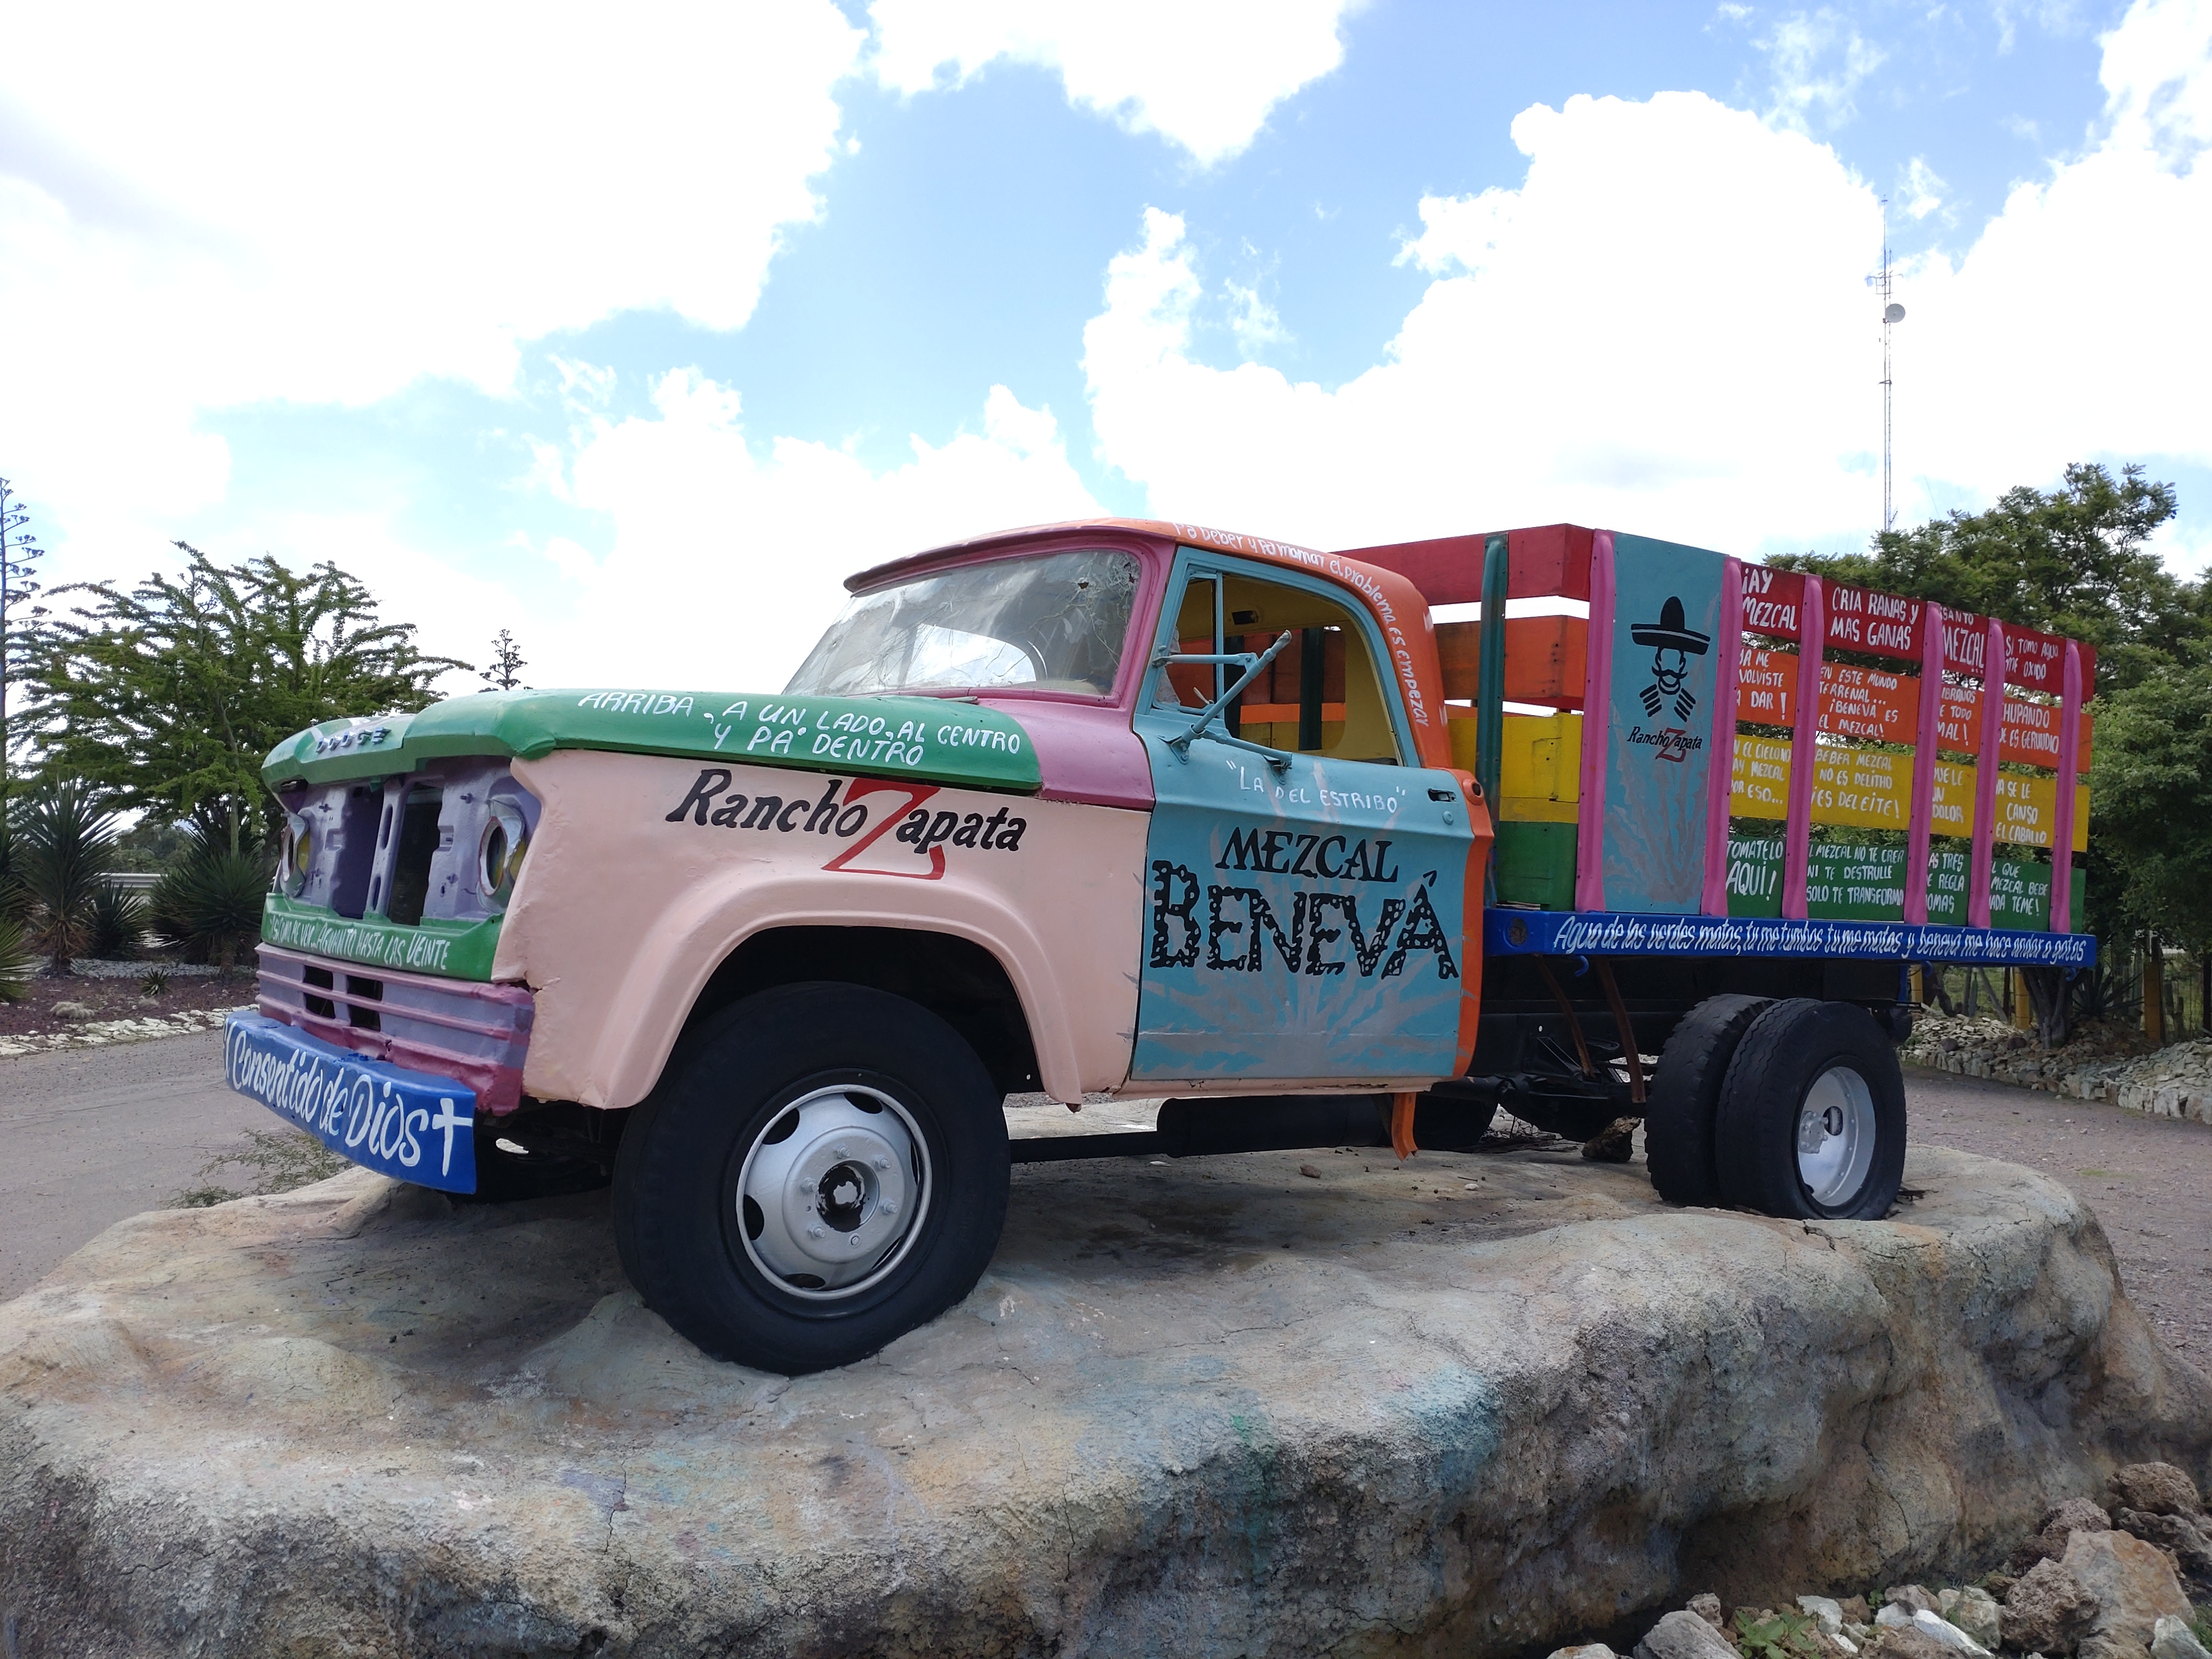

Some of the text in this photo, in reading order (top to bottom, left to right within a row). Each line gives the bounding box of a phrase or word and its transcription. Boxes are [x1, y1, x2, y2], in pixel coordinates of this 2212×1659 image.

[1199, 526, 1243, 549] beber
[1248, 536, 1258, 553] y
[1277, 543, 1325, 568] mamar
[1329, 559, 1344, 577] el
[1344, 566, 1396, 624] problema
[1743, 596, 1797, 631] MEZCAL
[1832, 587, 1862, 612] CRIA
[1868, 593, 1906, 622] RANAS
[1830, 616, 1911, 650] MAS GANAS
[2006, 635, 2014, 656] SI
[1756, 651, 1770, 667] ME
[1839, 669, 1864, 685] ESTE
[1867, 673, 1897, 690] MUNDO
[2023, 661, 2046, 680] OXIDO
[1942, 687, 1976, 703] IBRANOS
[1885, 709, 1898, 723] ES
[1939, 705, 1971, 720] E TODO
[2003, 703, 2050, 728] HUPANDO
[722, 701, 749, 720] A
[759, 704, 807, 726] UN
[897, 721, 926, 744] AL
[937, 725, 1020, 754] CENTRO
[1818, 714, 1884, 738] EL MEZCAL!
[316, 727, 392, 753] DODGE
[713, 726, 734, 750] Y
[812, 732, 924, 766] DENTRO
[1627, 726, 1702, 763] Rancho Zapata
[1734, 739, 1740, 755] N
[1743, 742, 1752, 758] EL
[2021, 731, 2059, 754] GERUNDIO
[1733, 758, 1785, 781] AY MEZCAL
[1856, 754, 1892, 771] MEZCAL
[1819, 768, 1834, 781] NO
[1837, 770, 1848, 786] ES
[1275, 786, 1311, 804] DEL
[2007, 781, 2017, 797] SE
[2021, 783, 2031, 799] LE
[665, 768, 1028, 880] Rancho Zapata
[1933, 804, 1964, 824] DOLOR
[2006, 802, 2038, 825] CANSO
[1996, 822, 2047, 844] EL CABALLO
[1215, 827, 1399, 882] MEZCAL
[1726, 840, 1783, 860] TOMATELO
[1815, 845, 1852, 859] MEZCAL
[1854, 846, 1866, 862] NO
[1869, 847, 1879, 863] TE
[1881, 849, 1904, 863] CREA
[1807, 865, 1892, 880] NI TE DESTRULLE
[1928, 853, 1964, 872] AS TRES
[2002, 863, 2021, 878] QUE
[1938, 874, 1964, 891] REGLA
[1991, 877, 2048, 896] MEZCAL BEBE
[1806, 885, 1904, 906] SOLO TE TRANSFORMA
[1926, 893, 1954, 914] OMAS
[1150, 860, 1459, 980] BENEVÁ
[316, 921, 357, 958] AGUANTO
[356, 928, 385, 958] HASTA
[384, 935, 405, 967] LAS
[406, 932, 451, 970] VEINTE
[1553, 915, 1603, 954] Agua
[1601, 915, 1624, 950] de
[1621, 917, 1647, 950] las
[1647, 917, 1695, 951] verdes
[1694, 919, 1743, 956] matas,
[1743, 921, 1760, 951] tu
[1757, 927, 1780, 952] me
[1778, 920, 1824, 952] tumbas
[1824, 923, 1840, 953] tu
[1839, 930, 1861, 954] me
[1860, 925, 1903, 953] matas
[1901, 932, 1915, 958] y
[1960, 933, 1983, 957] me
[1981, 930, 2011, 958] hace
[2011, 933, 2044, 959] andar
[2042, 940, 2052, 959] a
[2049, 936, 2086, 964] gatas
[232, 1030, 323, 1123] Consentido
[319, 1067, 348, 1136] de
[345, 1074, 429, 1167] Dios
